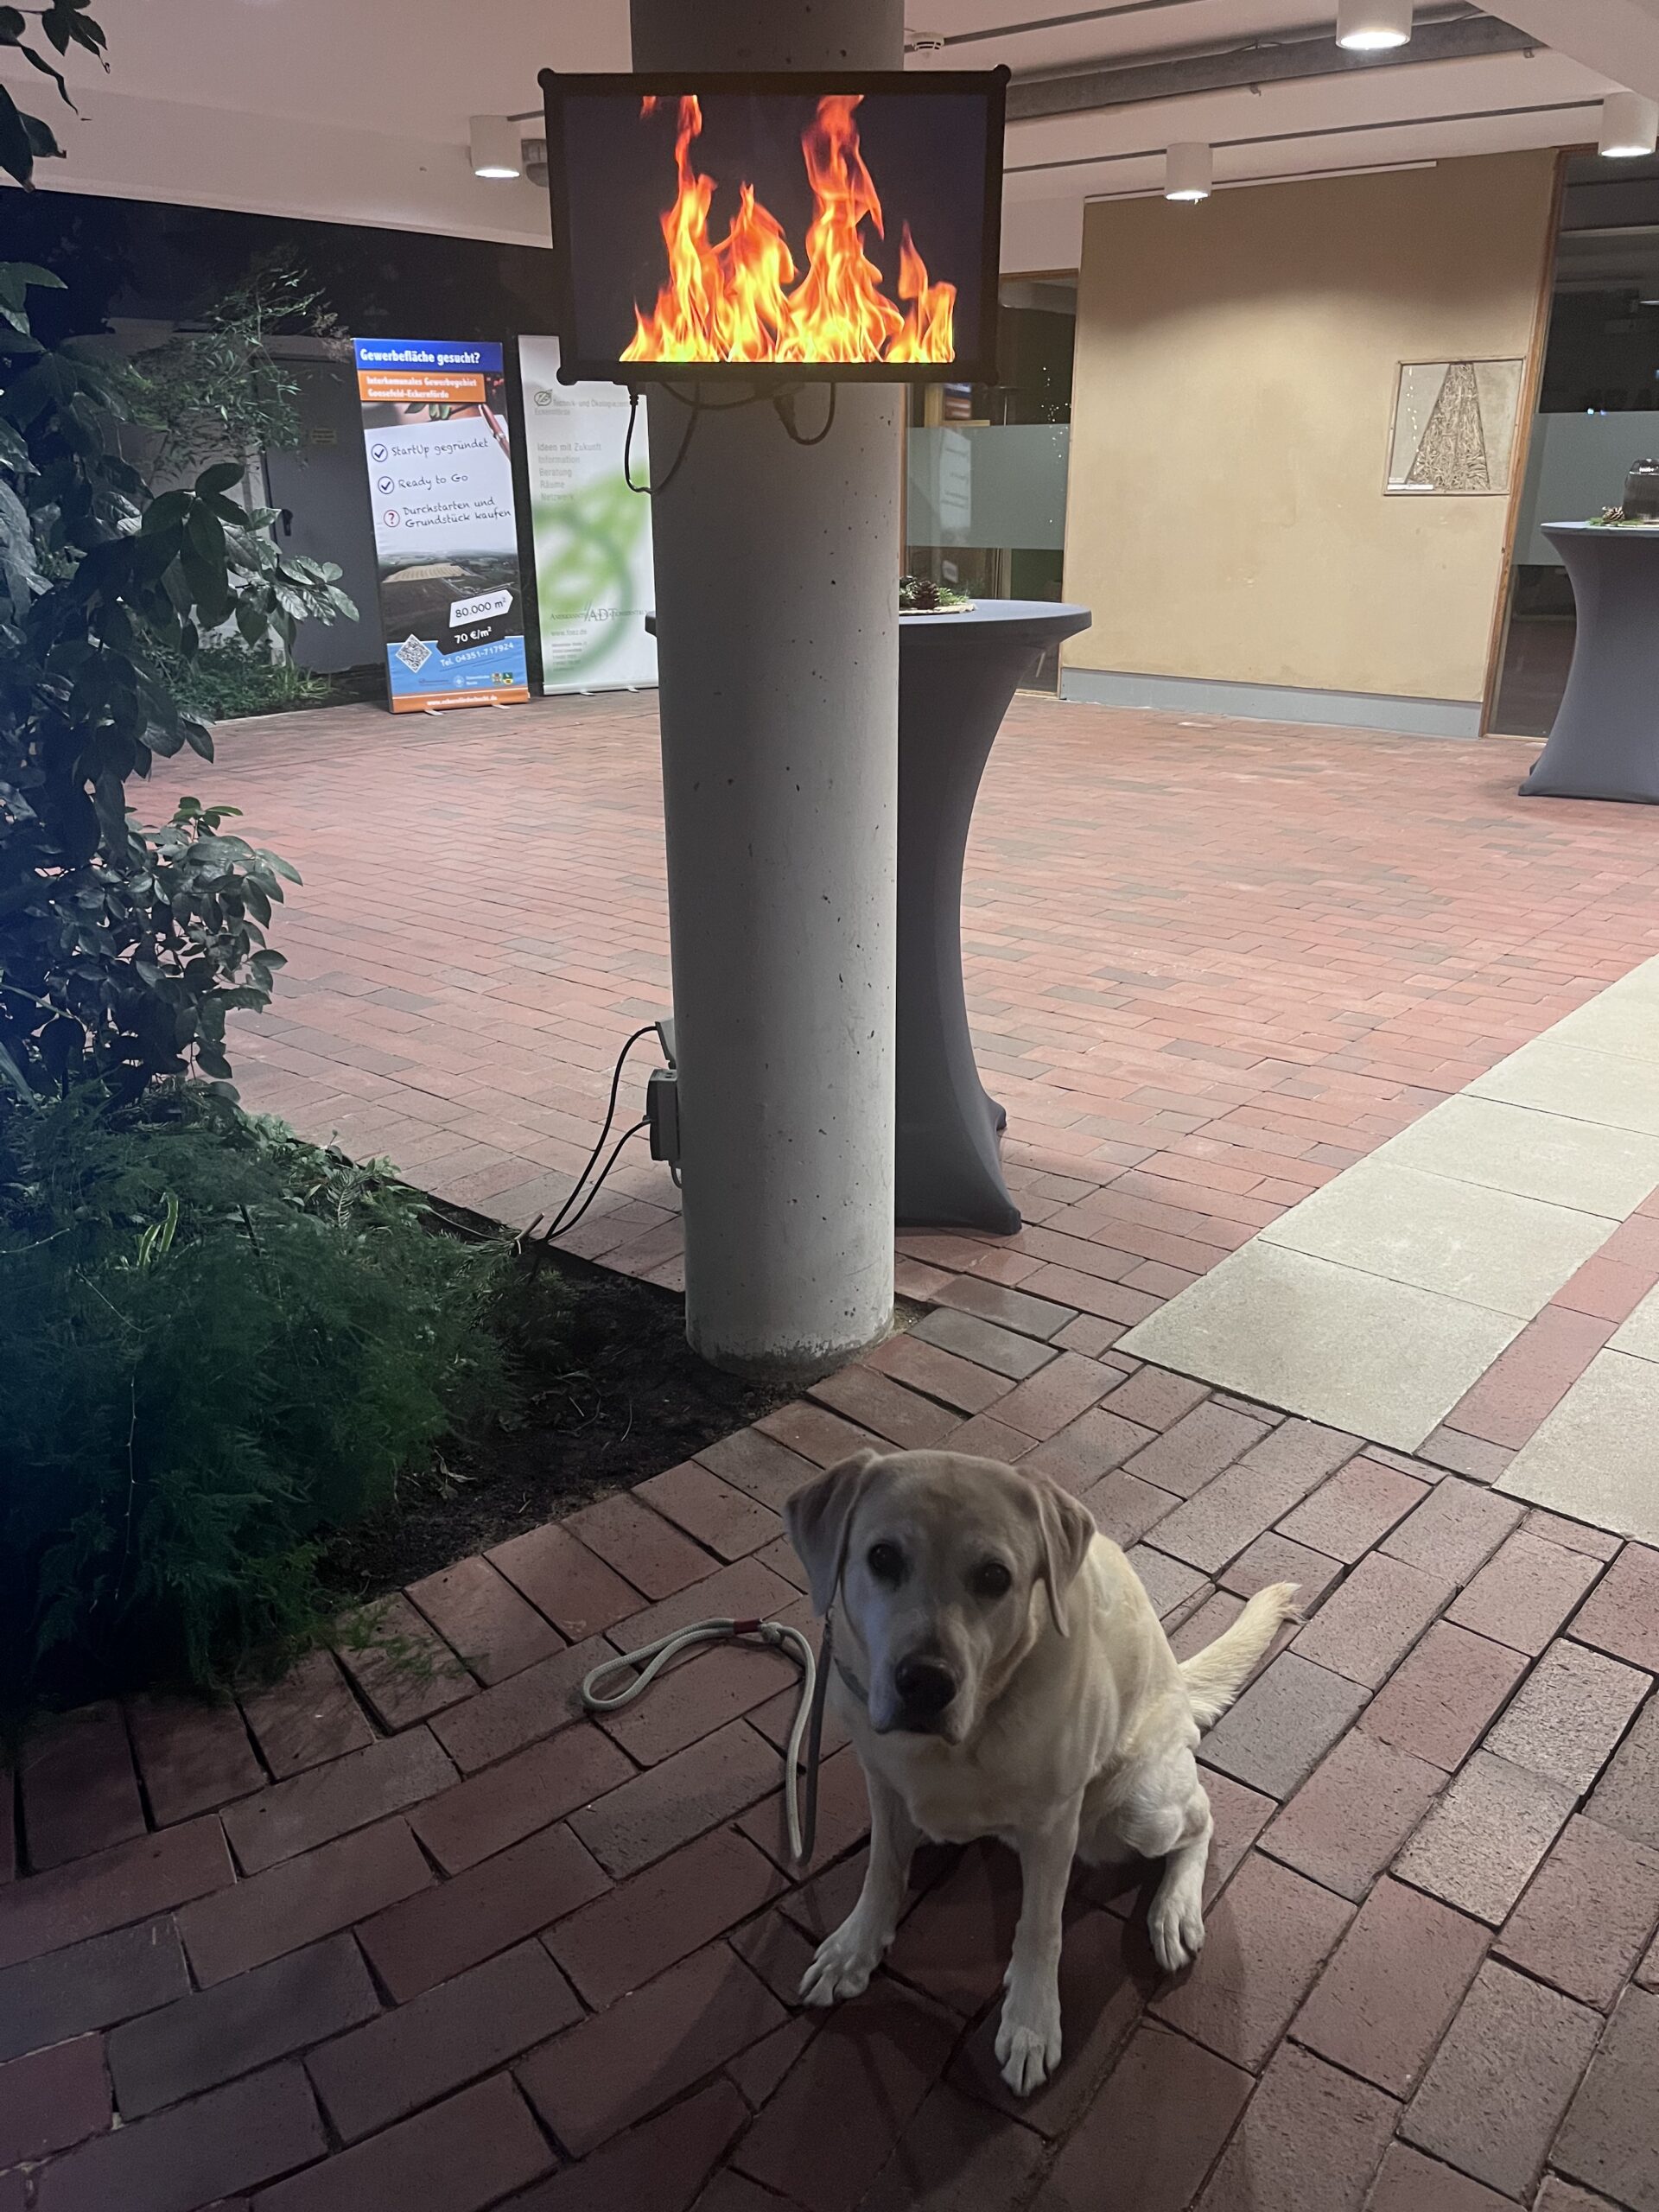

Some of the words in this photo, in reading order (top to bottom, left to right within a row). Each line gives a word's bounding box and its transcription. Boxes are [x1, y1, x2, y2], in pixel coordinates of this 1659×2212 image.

[360, 348, 435, 363] Gewerbefläche
[437, 352, 480, 365] gesucht?
[391, 444, 429, 458] StartUp
[435, 438, 489, 455] gegründet
[560, 442, 571, 451] mit
[398, 477, 431, 490] Ready
[435, 475, 447, 484] to
[451, 474, 468, 482] Go
[403, 502, 470, 516] Durchstarten
[474, 497, 495, 507] und
[405, 513, 470, 528] Grundstück
[475, 508, 512, 520] kaufen
[455, 601, 492, 618] 80.000
[454, 633, 468, 644] 70
[455, 643, 514, 663] 04351-717924
